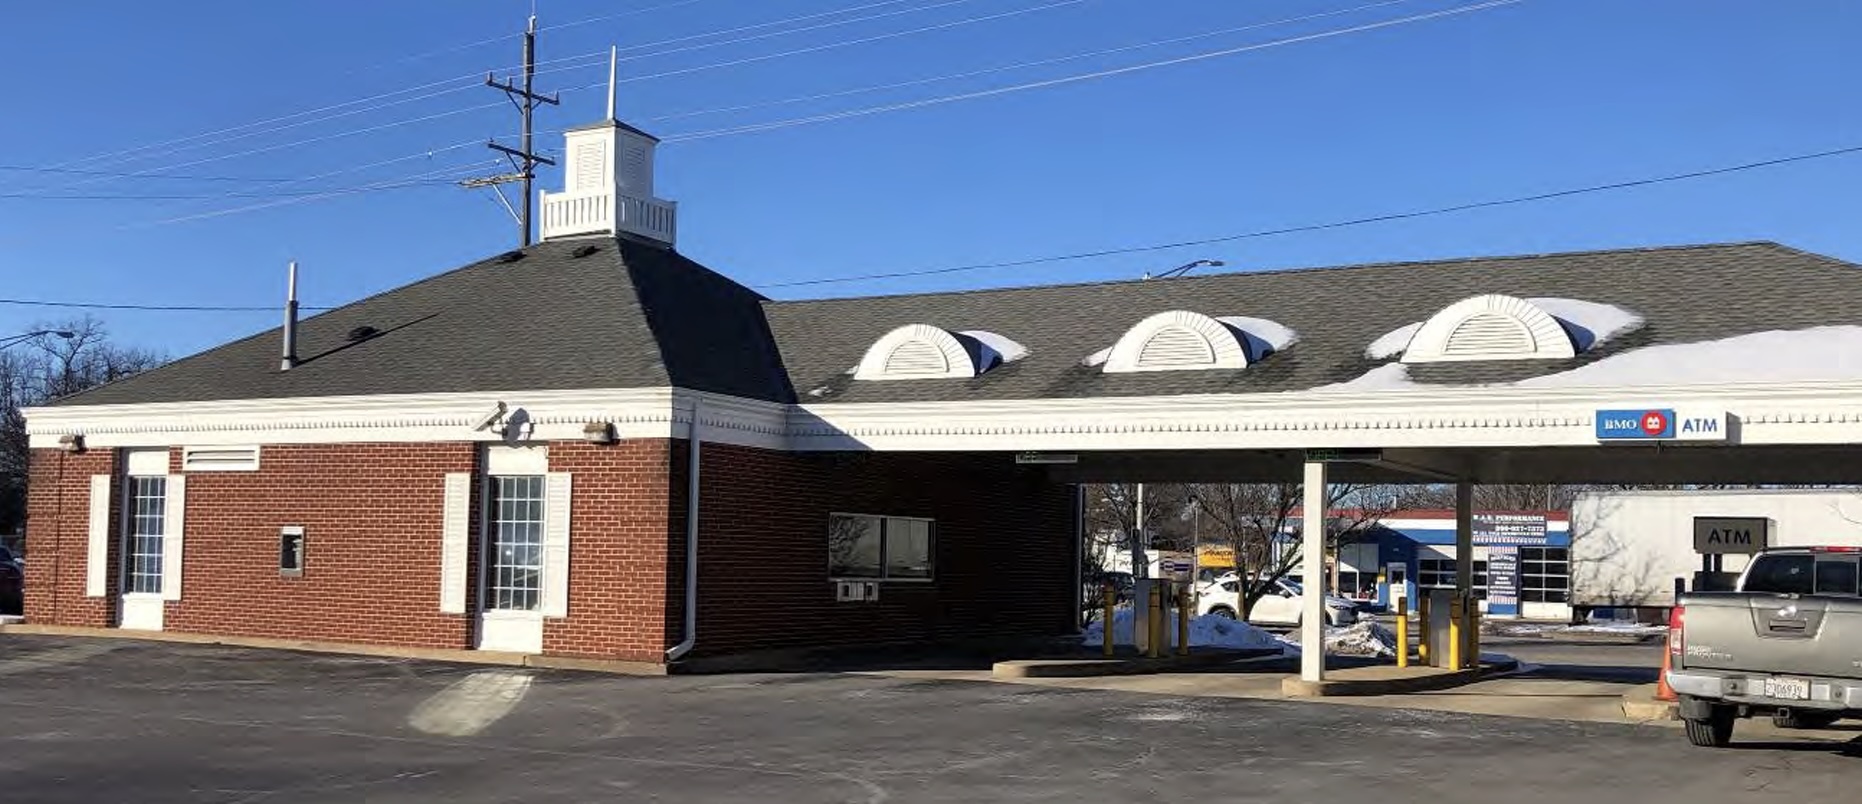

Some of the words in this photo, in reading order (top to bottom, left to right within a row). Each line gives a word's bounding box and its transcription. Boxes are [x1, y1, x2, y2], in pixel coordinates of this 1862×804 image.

[1604, 419, 1637, 430] BMO
[1682, 418, 1718, 433] ATM
[1708, 528, 1751, 545] ATM
